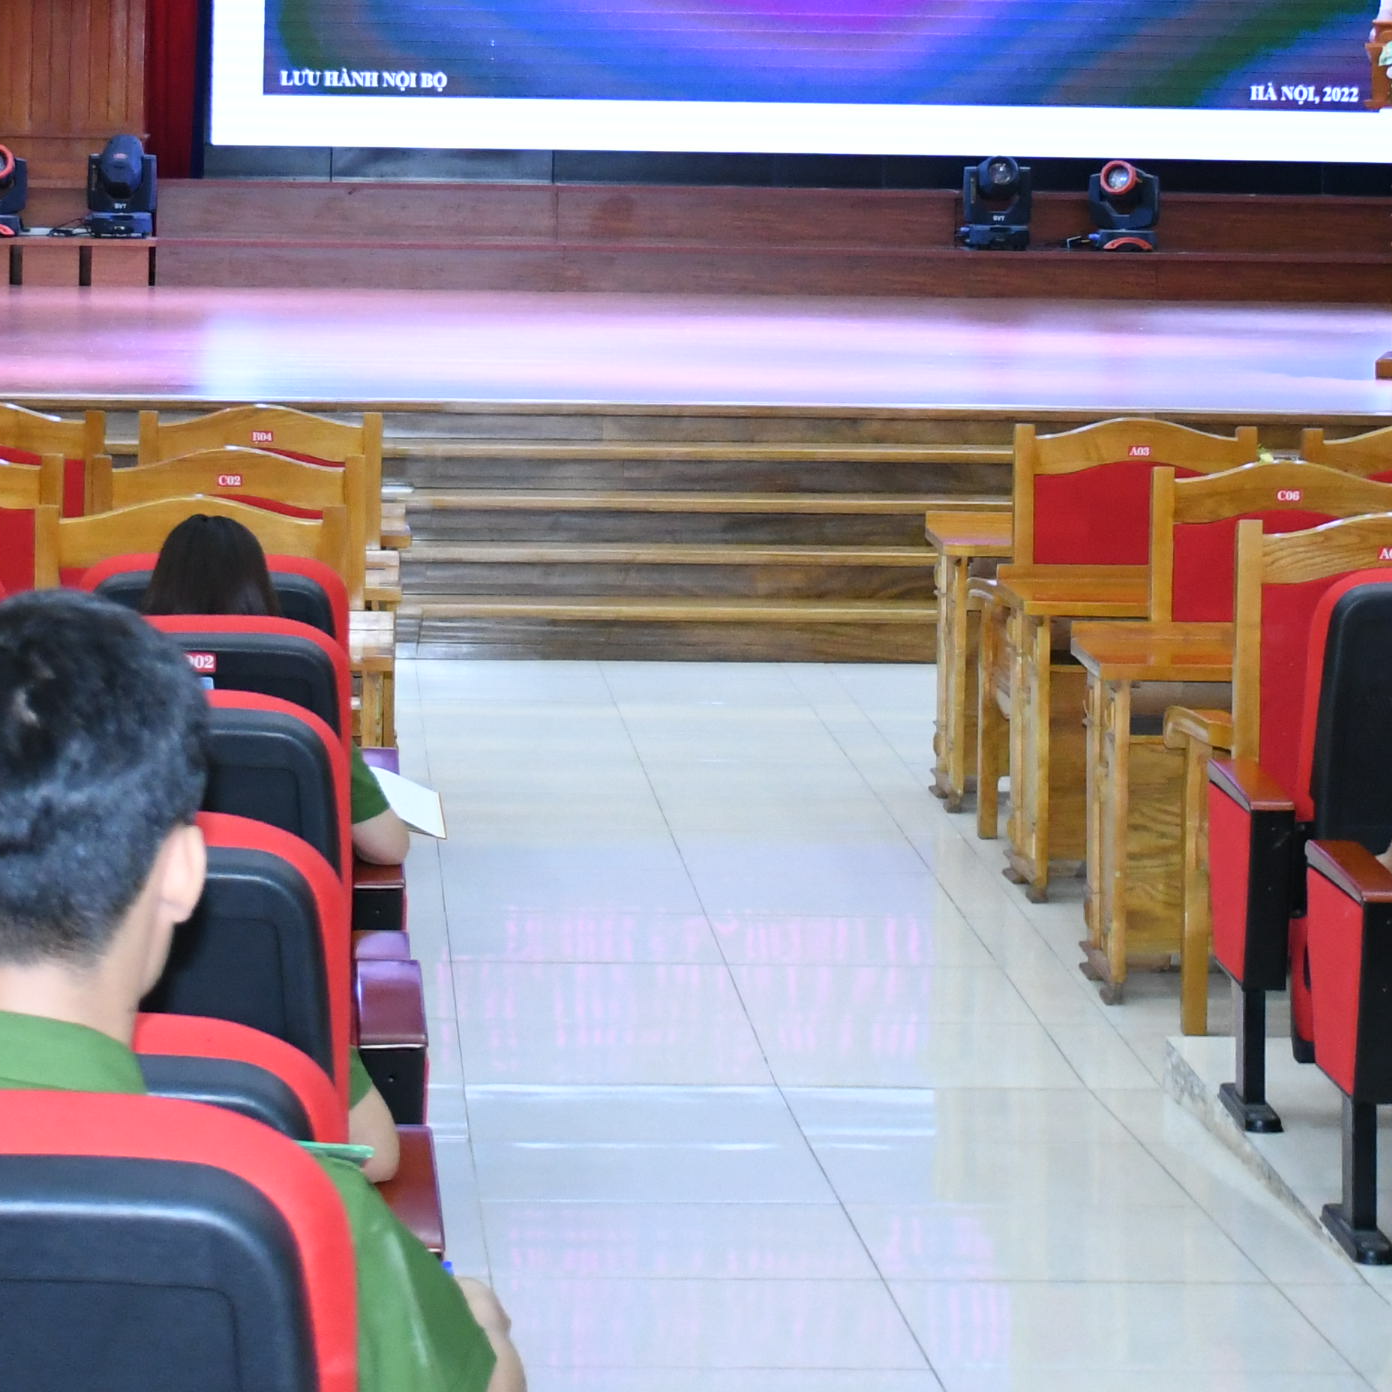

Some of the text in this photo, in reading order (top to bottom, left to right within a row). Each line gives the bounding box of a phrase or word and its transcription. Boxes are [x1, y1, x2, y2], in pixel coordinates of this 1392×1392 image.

[280, 66, 448, 92] LƯU HÀNH NỘI BỘ
[1250, 81, 1359, 105] HÀ NỘI, 2022
[252, 431, 273, 442] B04
[1129, 446, 1150, 457] A03
[218, 474, 241, 486] C02
